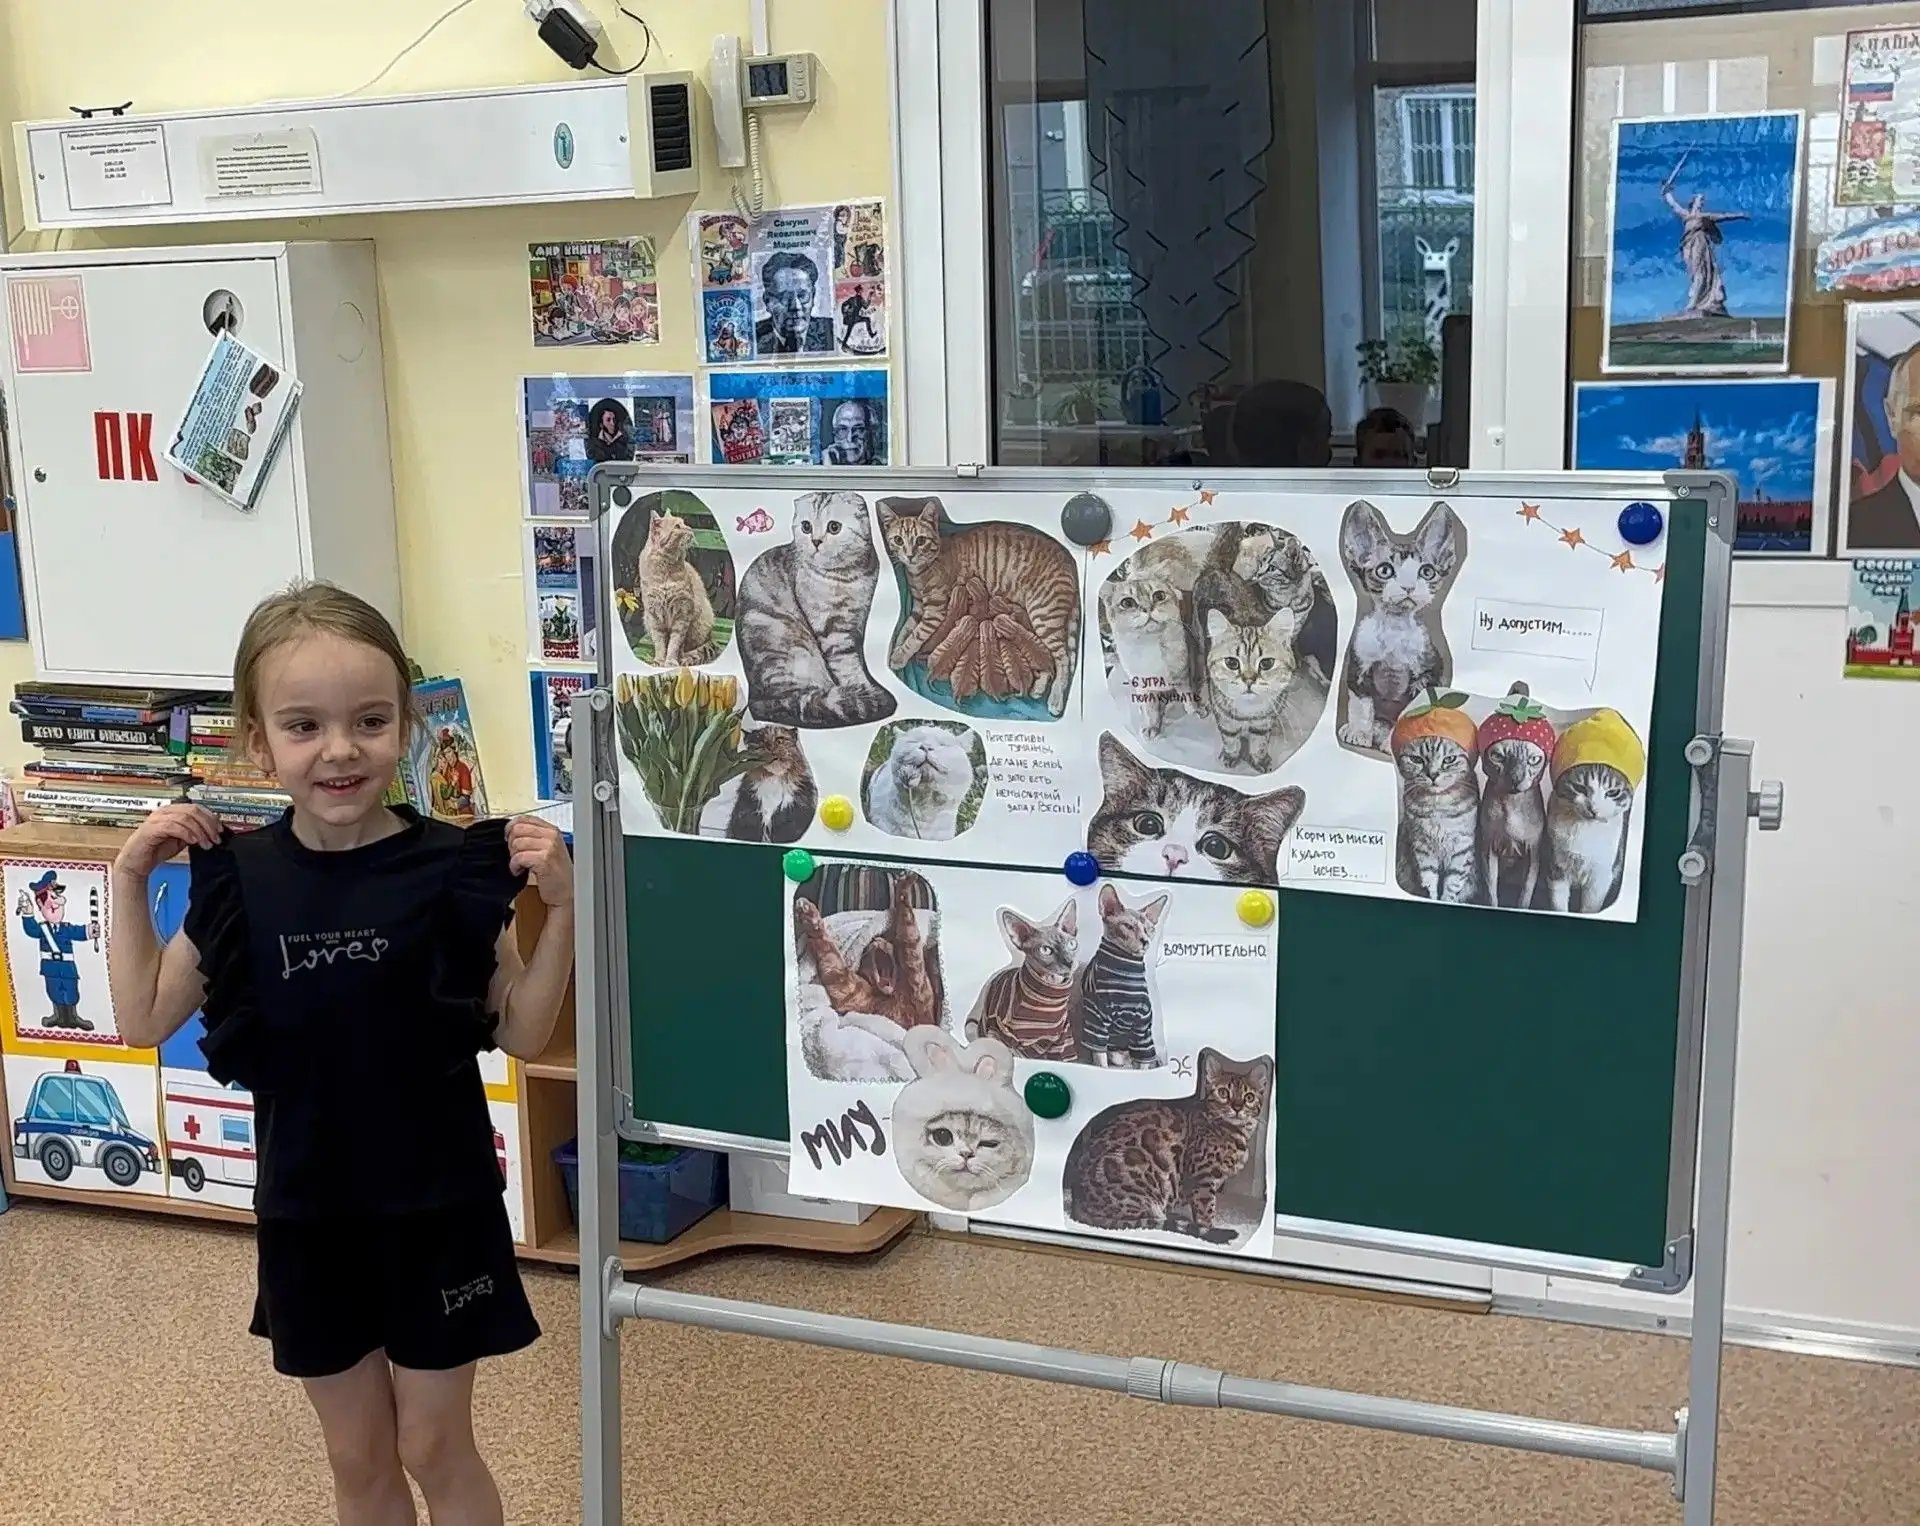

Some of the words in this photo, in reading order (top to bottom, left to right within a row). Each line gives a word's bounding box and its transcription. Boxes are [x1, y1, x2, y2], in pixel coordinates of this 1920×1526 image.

[774, 218, 808, 229] Самуил
[767, 230, 817, 240] Яковлевич
[564, 244, 600, 255] КНИГИ
[773, 240, 810, 250] Маршак
[94, 411, 159, 482] ПК
[1480, 611, 1494, 631] Ну
[1131, 692, 1156, 703] ПОРА
[1157, 691, 1202, 706] КУШАТЬ
[67, 726, 97, 743] КНИГА
[99, 726, 148, 745] СЕРЕБРЯНАЯ
[1028, 775, 1052, 785] ЕСТЬ
[287, 934, 312, 943] FUEL
[315, 932, 341, 941] YOUR
[343, 928, 376, 938] HEART
[1163, 943, 1267, 957] ВОЗМУТИТЕЛЬНО
